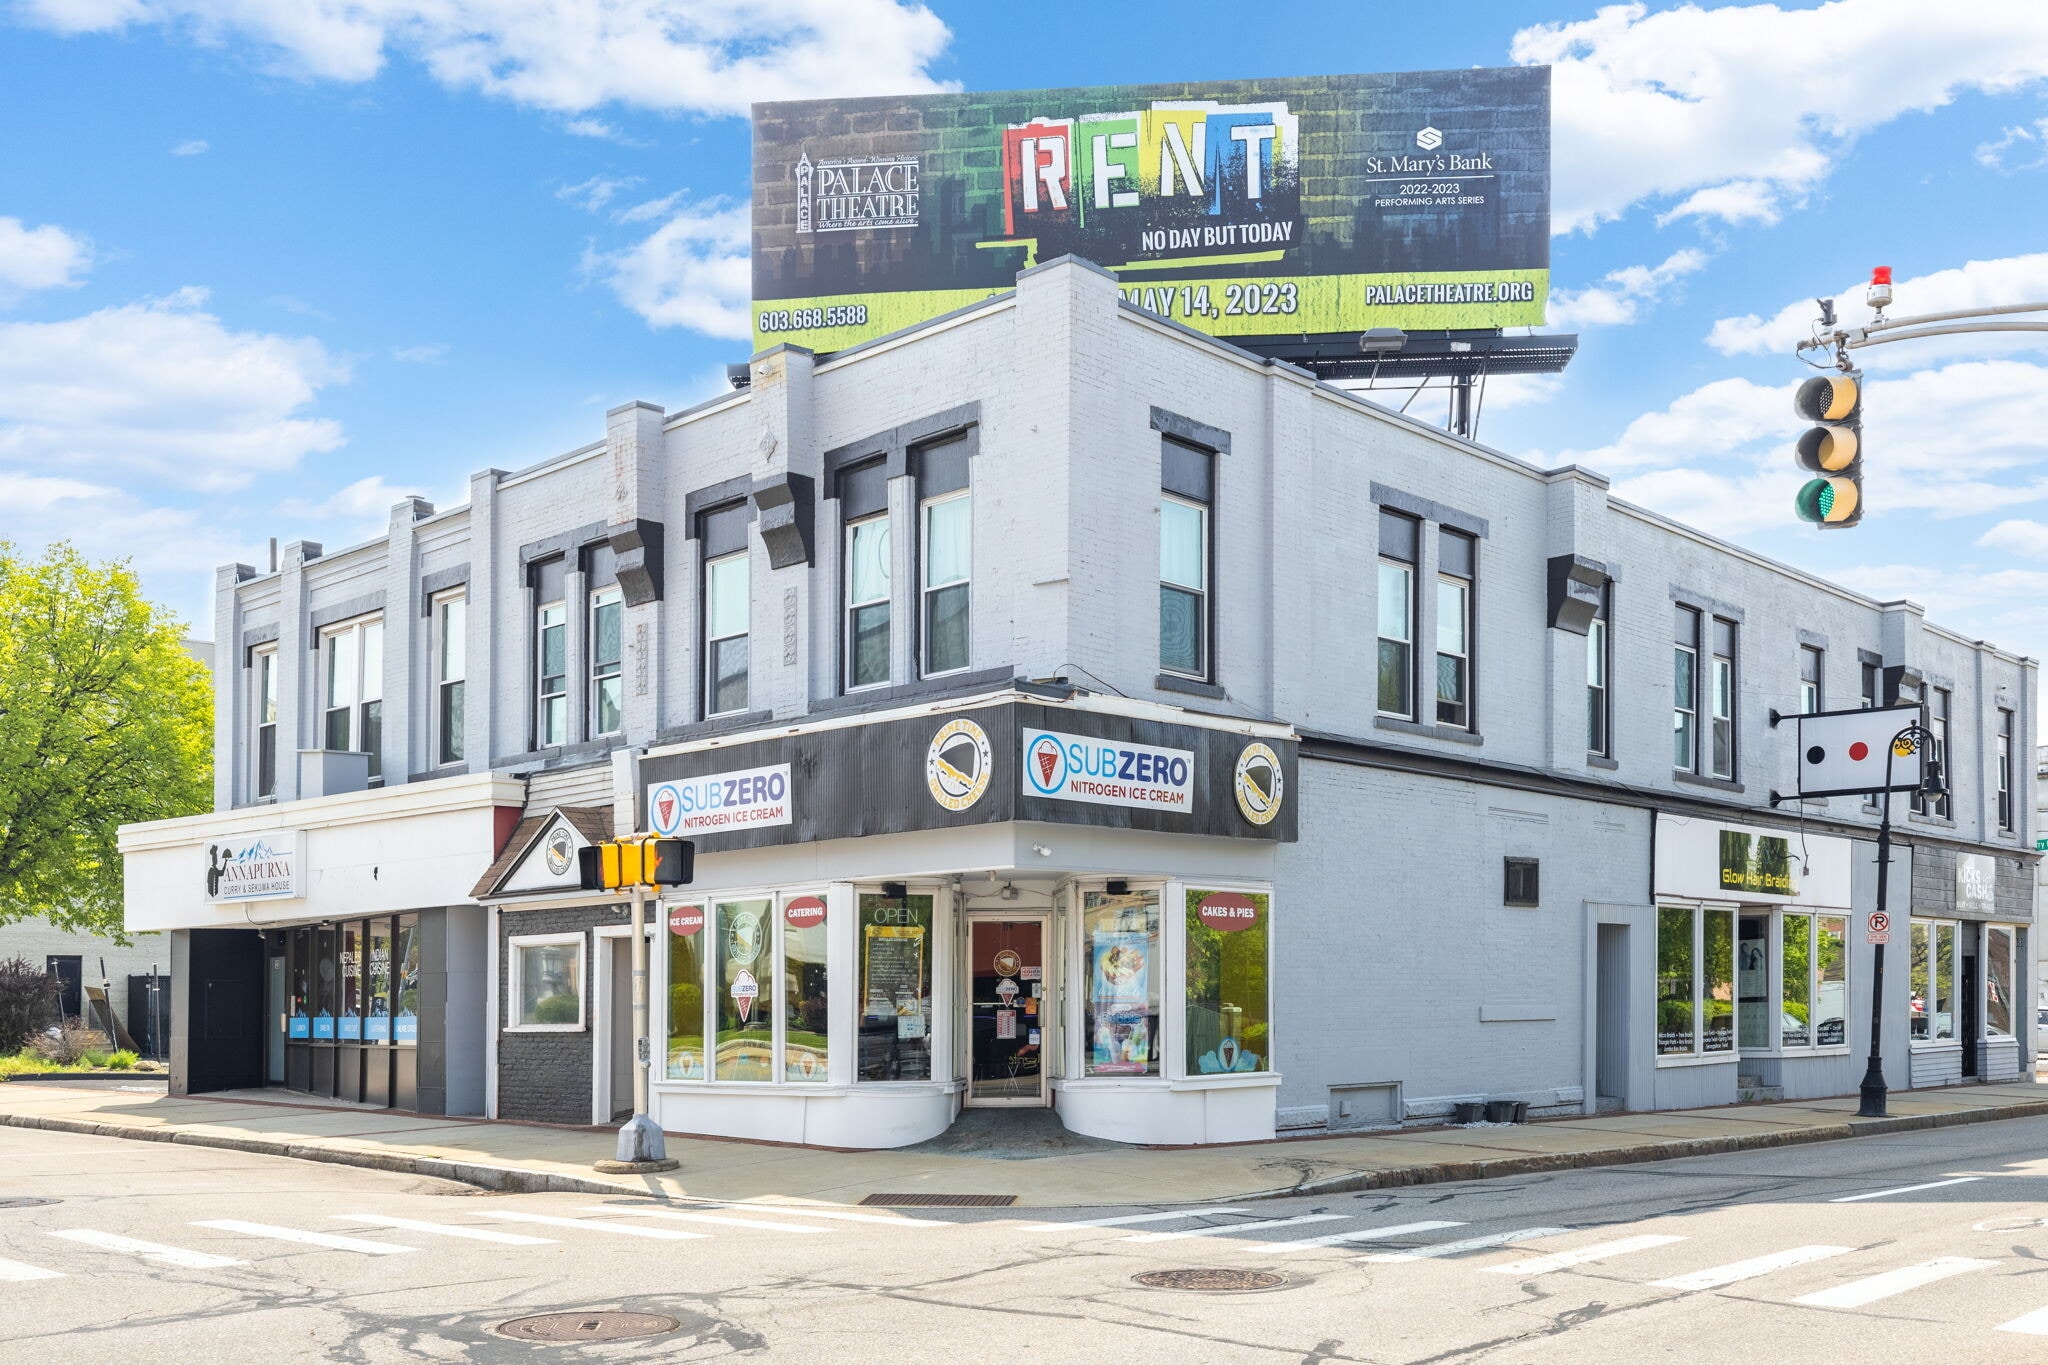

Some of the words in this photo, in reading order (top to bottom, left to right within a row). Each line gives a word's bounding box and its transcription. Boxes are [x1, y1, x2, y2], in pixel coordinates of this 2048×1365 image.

[1021, 121, 1276, 213] RENT
[1366, 156, 1387, 173] St.
[1390, 154, 1445, 176] Mary's
[1449, 153, 1493, 171] Bank
[816, 164, 919, 196] PALACE
[1399, 183, 1460, 195] 2022-2023
[816, 193, 919, 221] THEATRE
[1375, 197, 1432, 207] PERFORMING
[1435, 196, 1456, 205] ARTS
[1457, 195, 1484, 204] SERIES
[819, 221, 842, 229] Where
[1142, 230, 1166, 251] NO
[1169, 227, 1201, 249] DAY
[1204, 225, 1237, 247] BUT
[1239, 221, 1293, 244] TODAY
[1225, 282, 1299, 315] 2023
[1365, 281, 1533, 307] PALACETHEATRE.ORG
[757, 304, 868, 334] 603.668.5588
[935, 721, 960, 747] PRIME
[961, 720, 982, 742] TIME
[1068, 743, 1188, 787] SUBZERO
[1242, 745, 1260, 763] PRIME
[1260, 745, 1278, 765] TIME
[681, 772, 786, 813] SUBZERO
[929, 778, 960, 809] GRILLED
[960, 772, 988, 809] CHEESE
[1070, 779, 1127, 798] NITROGEN
[1129, 786, 1147, 801] ICE
[1149, 789, 1184, 805] CREAM
[684, 812, 731, 830] NITROGEN
[732, 811, 748, 824] ICE
[750, 806, 784, 822] CREAM
[223, 860, 290, 883] ANNAPURNA
[1722, 868, 1744, 884] Glow
[1746, 872, 1763, 886] Hair
[1958, 867, 1981, 884] KICKS
[271, 880, 290, 891] HOUSE
[1965, 884, 1987, 900] CASH
[669, 918, 682, 927] ICE
[682, 915, 703, 926] CREAM
[788, 906, 823, 918] CATERING
[874, 907, 918, 924] OPEN
[1202, 906, 1227, 918] CAKES
[1228, 906, 1237, 918] &
[1237, 907, 1254, 919] PIES
[369, 948, 389, 962] INDIAN
[341, 964, 362, 978] CUISINE
[369, 961, 390, 975] CUISINE
